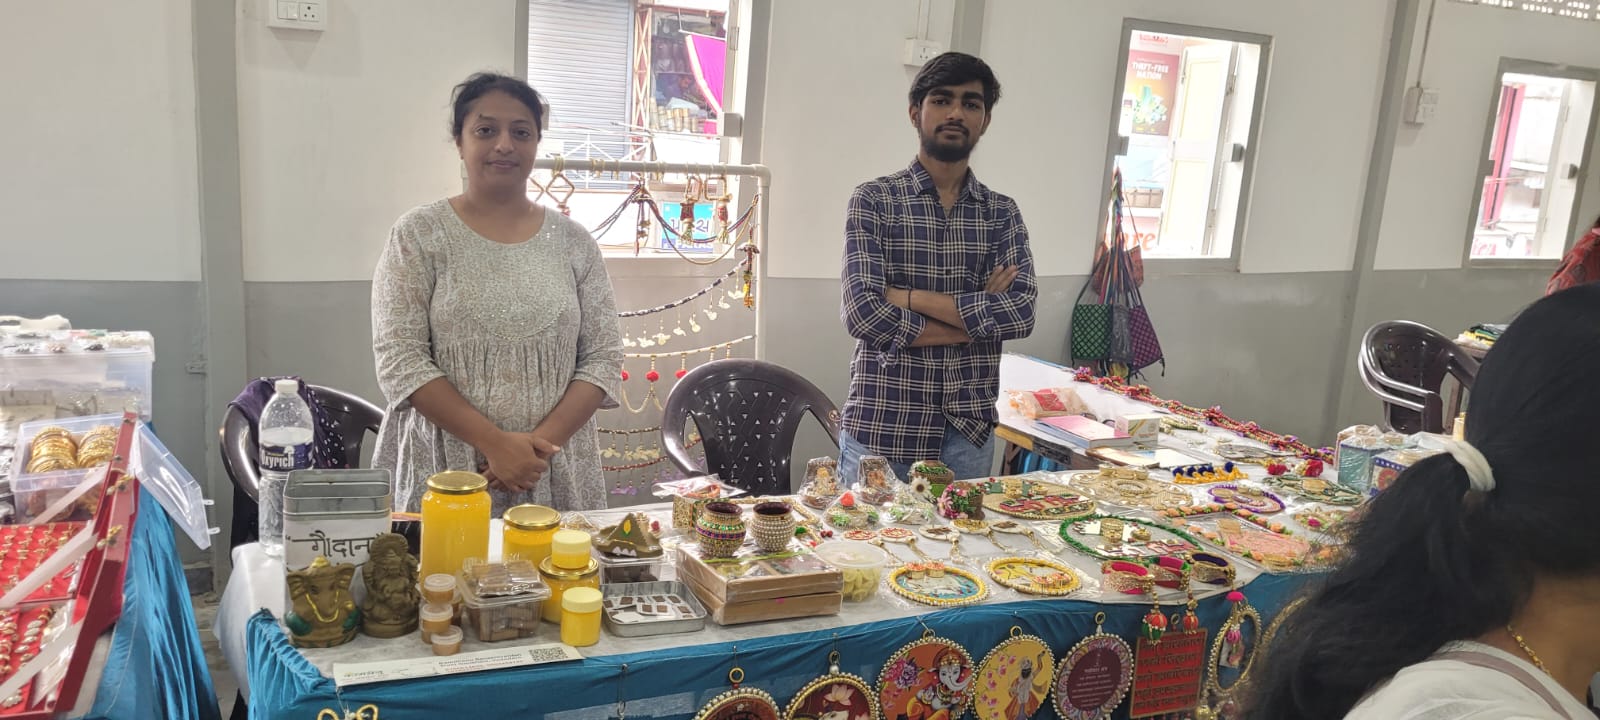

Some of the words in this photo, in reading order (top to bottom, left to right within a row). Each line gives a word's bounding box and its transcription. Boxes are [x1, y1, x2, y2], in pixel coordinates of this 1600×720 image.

[1132, 62, 1169, 74] THEFT-FREE
[1136, 71, 1162, 81] NATION
[261, 451, 295, 469] Oxyrich
